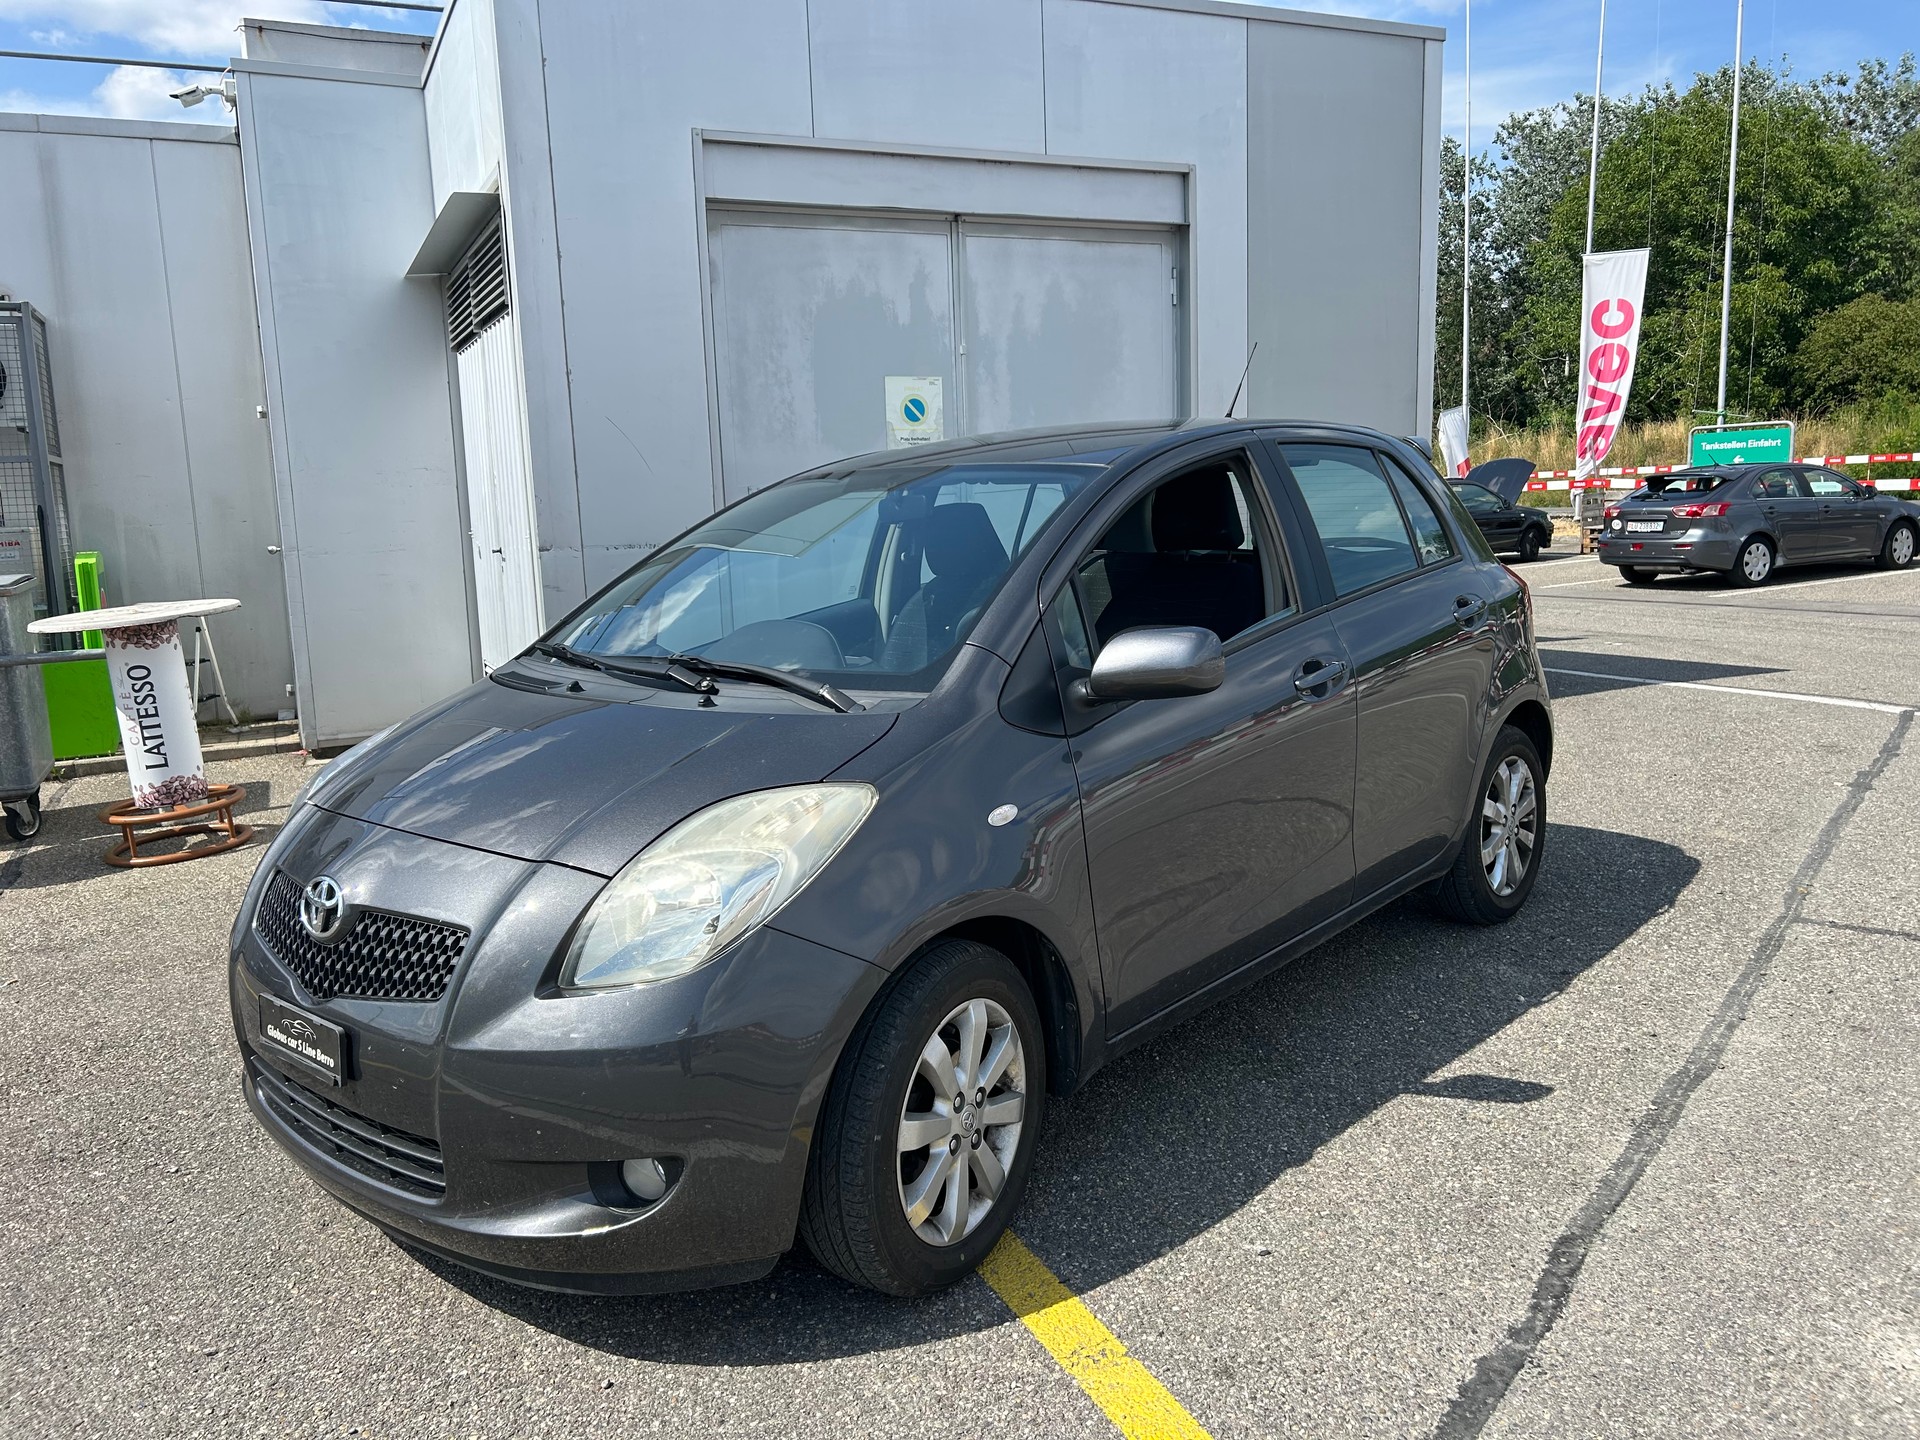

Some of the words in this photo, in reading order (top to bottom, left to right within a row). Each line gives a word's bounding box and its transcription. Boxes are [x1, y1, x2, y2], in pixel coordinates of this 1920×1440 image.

[1578, 298, 1635, 461] avec
[1701, 440, 1746, 450] Tankstellen
[1747, 438, 1782, 448] Einfahrt
[126, 664, 169, 771] LATTESSO
[267, 1024, 288, 1044] Globus
[288, 1036, 298, 1049] car
[302, 1041, 317, 1059] Line
[316, 1048, 335, 1068] Berro
